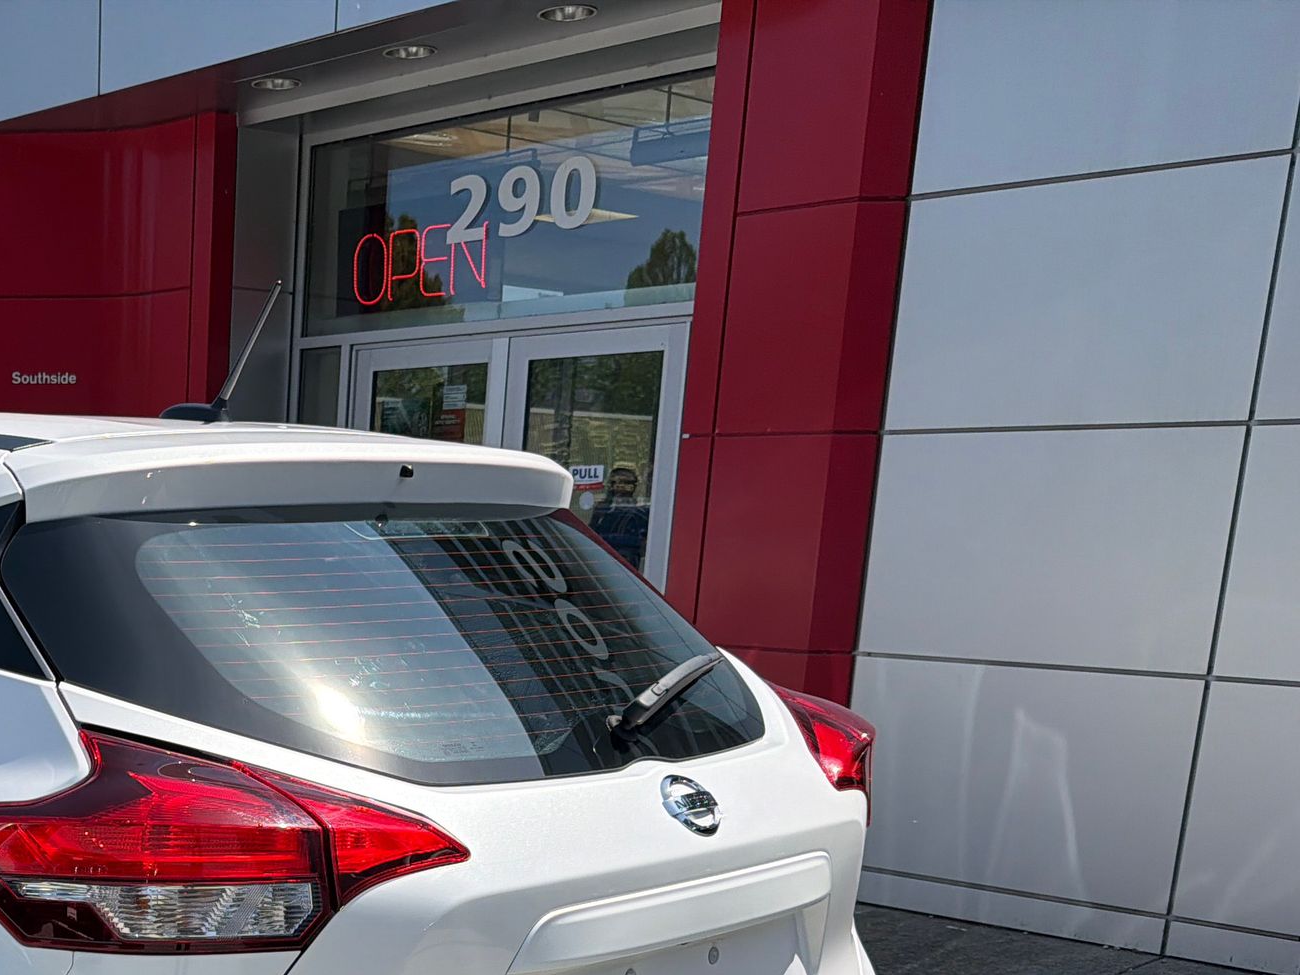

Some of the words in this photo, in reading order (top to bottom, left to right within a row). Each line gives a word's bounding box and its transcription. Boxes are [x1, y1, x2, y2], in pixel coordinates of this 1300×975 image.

[446, 156, 597, 245] 290
[353, 220, 489, 306] OPEN
[11, 371, 77, 385] Southside
[572, 467, 599, 479] PULL
